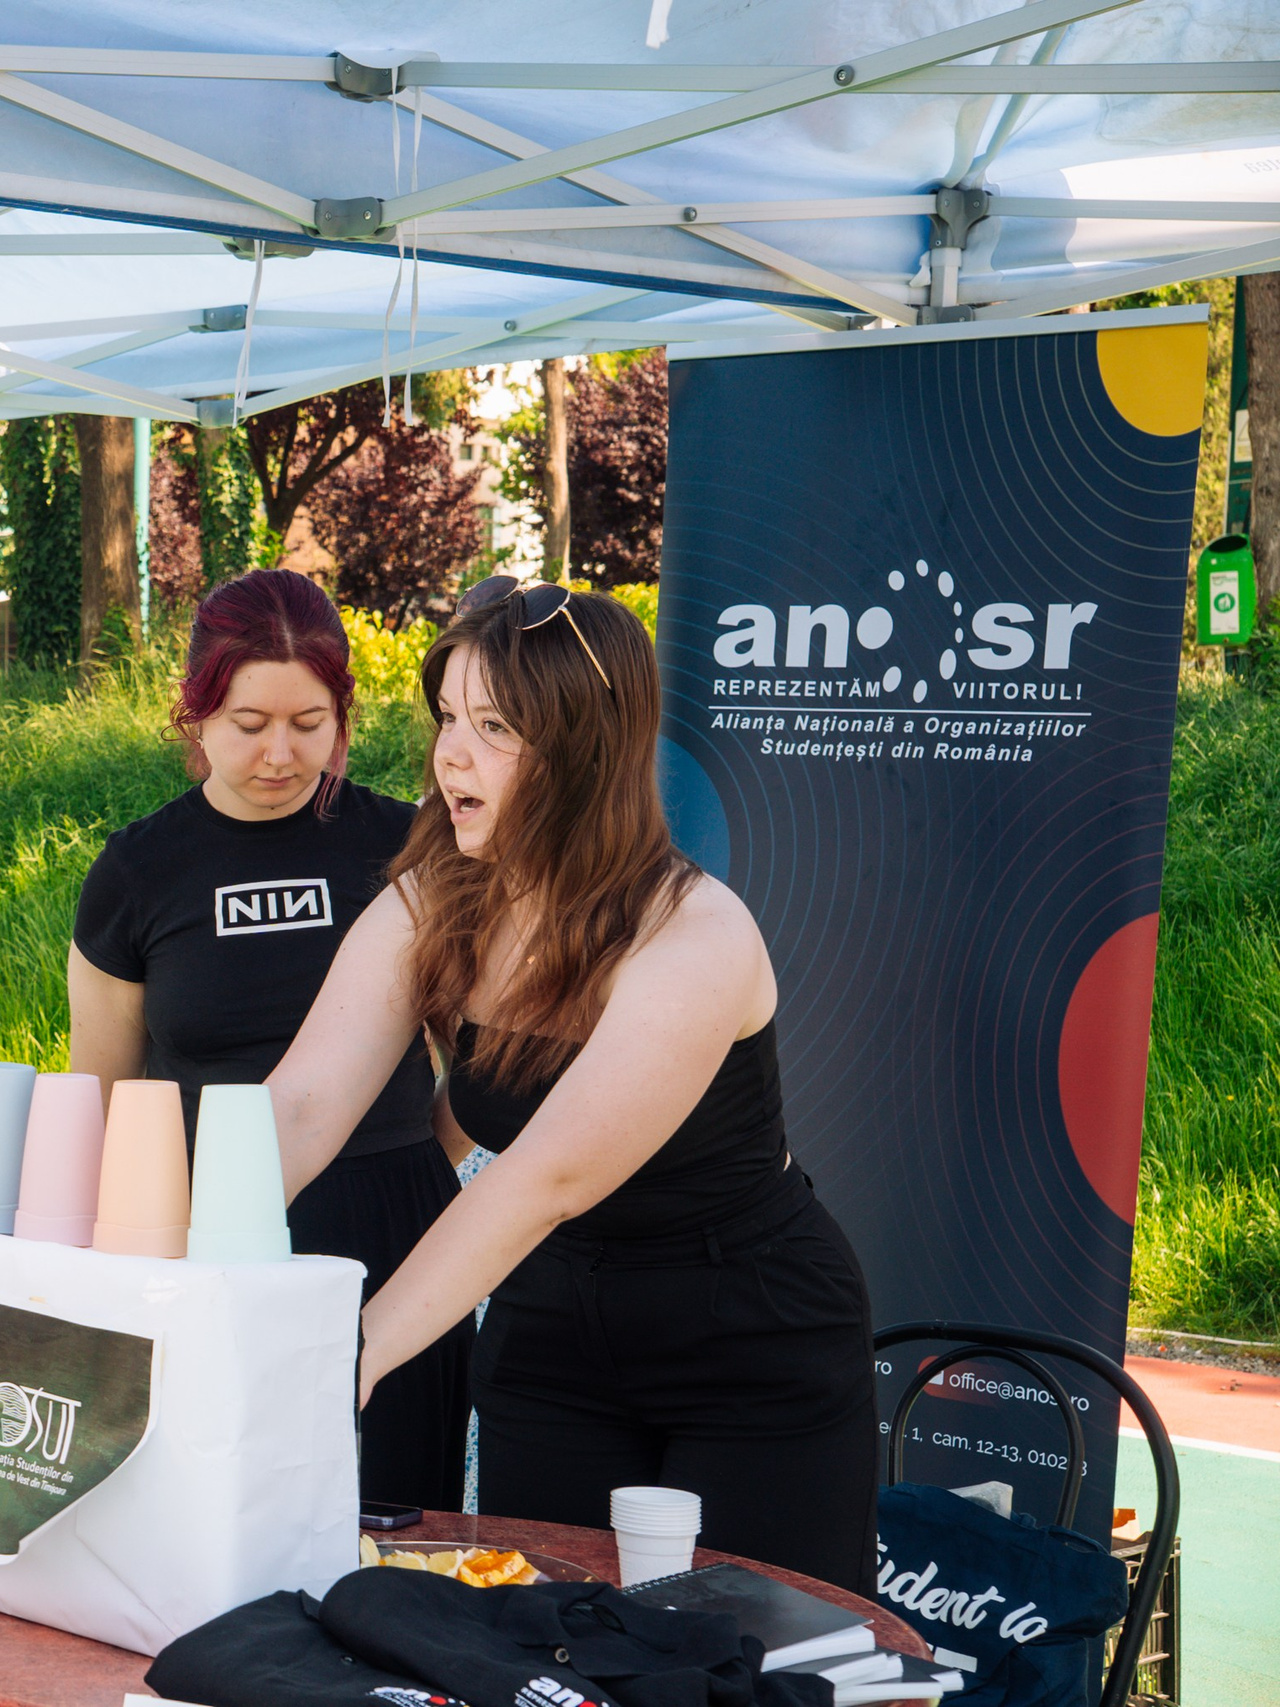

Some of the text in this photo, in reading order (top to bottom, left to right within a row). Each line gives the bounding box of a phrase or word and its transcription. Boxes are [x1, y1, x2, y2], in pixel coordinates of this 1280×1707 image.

[713, 678, 1083, 701] REPREZENTĂM VIITORUL!
[711, 713, 1087, 740] Alianța Națională a Organizațiilor
[760, 739, 1033, 763] Studențești din România
[949, 1372, 1090, 1411] office@anosro
[932, 1432, 971, 1451] cam.
[976, 1440, 1022, 1462] 12-13,
[6, 1470, 16, 1482] de
[16, 1473, 30, 1486] Vest
[29, 1477, 41, 1488] din
[61, 1470, 74, 1484] din
